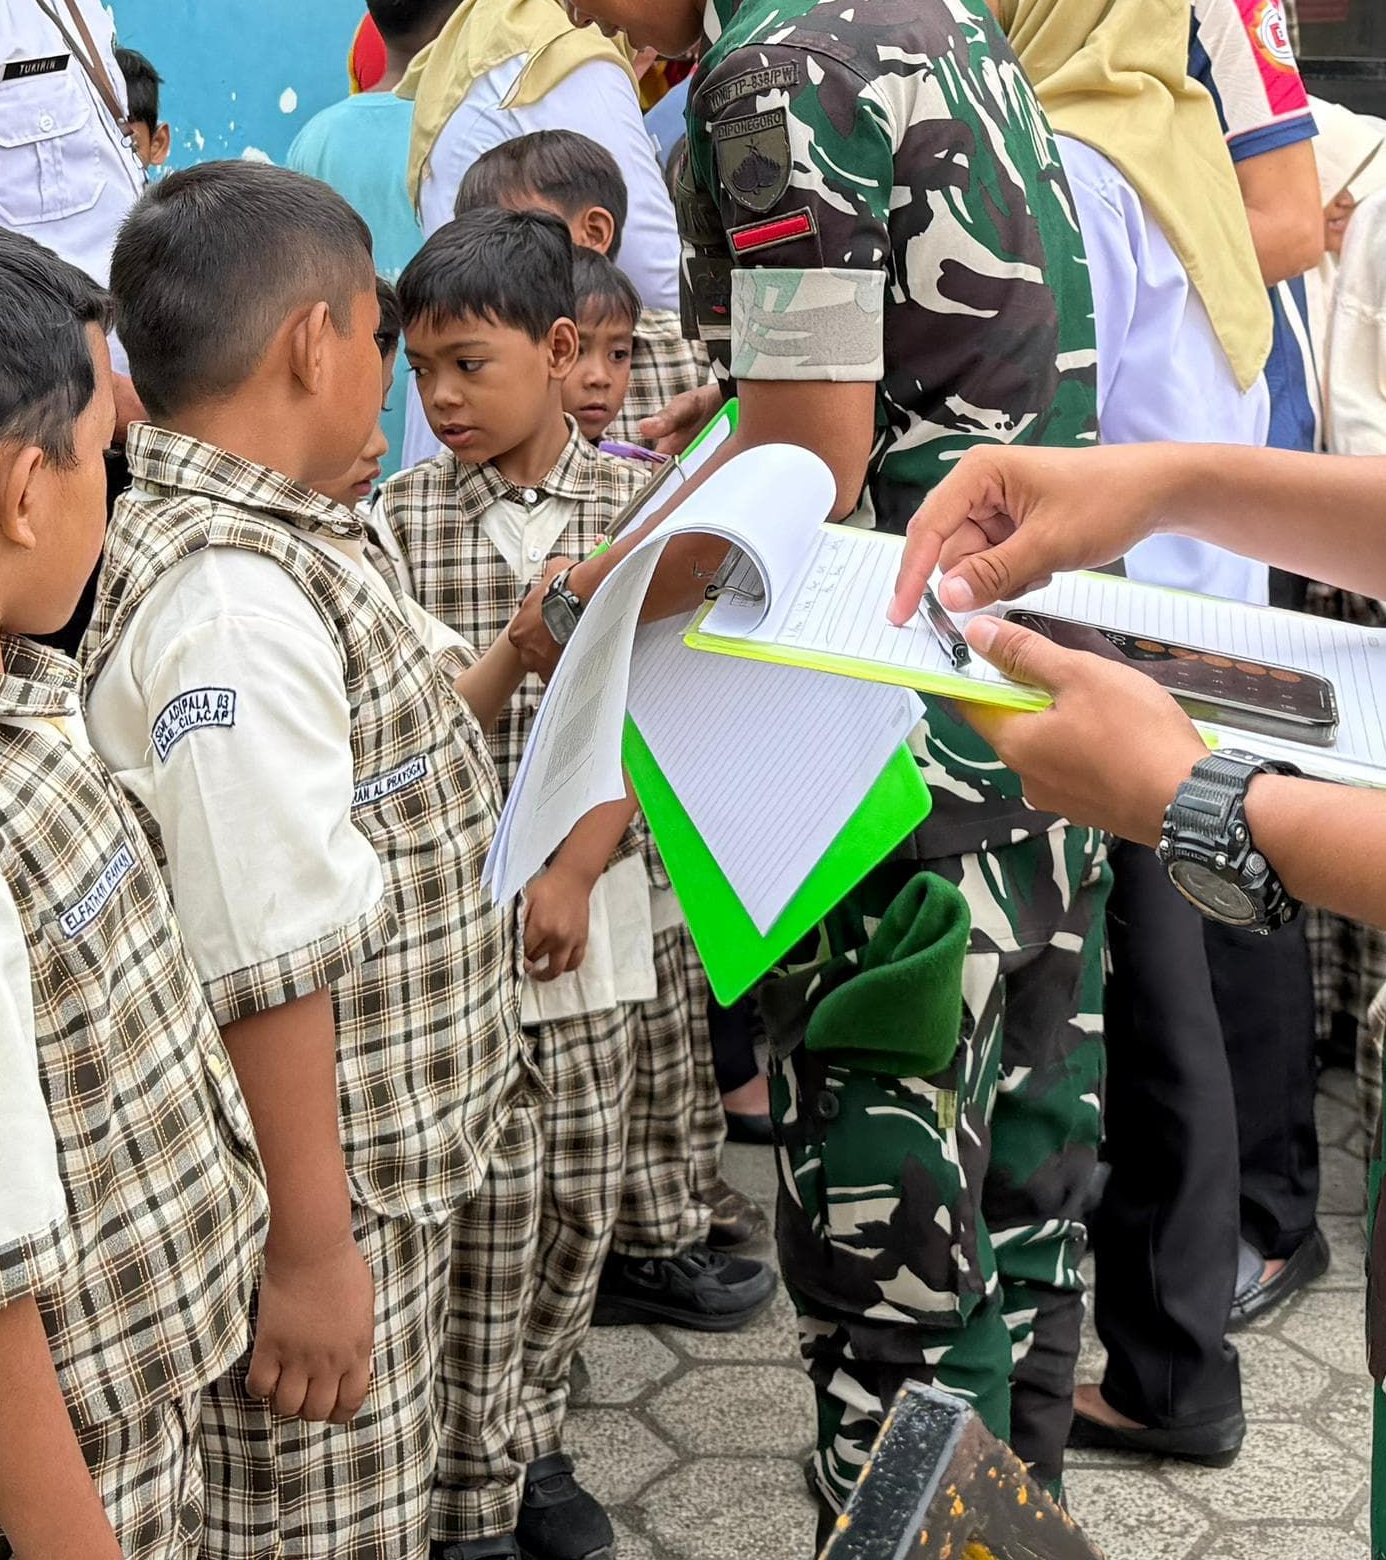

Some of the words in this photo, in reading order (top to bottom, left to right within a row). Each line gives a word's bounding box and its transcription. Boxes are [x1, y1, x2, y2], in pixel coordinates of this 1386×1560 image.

[717, 111, 781, 139] DIPONEGORO
[169, 692, 211, 725] ADIPALA
[217, 692, 230, 710] 03
[178, 708, 230, 729] CILACAP
[373, 781, 384, 796] AL
